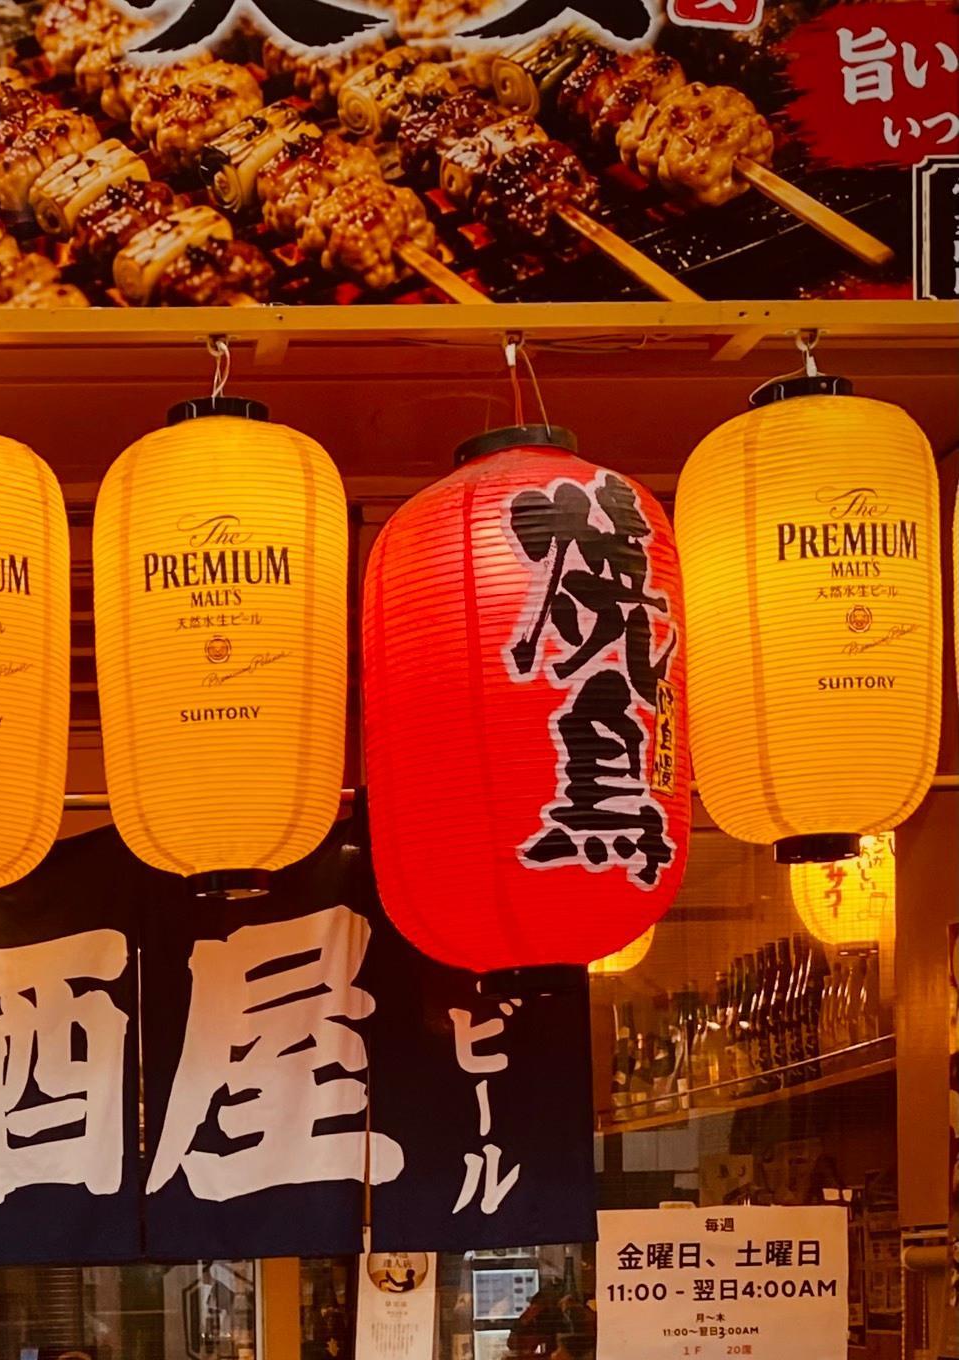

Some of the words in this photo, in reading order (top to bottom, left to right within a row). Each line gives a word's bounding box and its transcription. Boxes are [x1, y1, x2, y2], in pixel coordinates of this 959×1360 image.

[836, 27, 958, 104] 旨い
[776, 519, 918, 561] PREMIUM
[144, 545, 291, 592] PREMIUM
[830, 561, 881, 577] MALT'S
[190, 588, 242, 608] MALT'S
[818, 676, 895, 690] SUNTORY
[180, 706, 261, 722] SUNTORY
[448, 997, 521, 1215] ビール
[705, 1217, 735, 1232] 毎週
[617, 1240, 821, 1271] 金曜日、土曜日
[607, 1283, 667, 1302] 11:00
[693, 1279, 837, 1302] 翌日4:00AM
